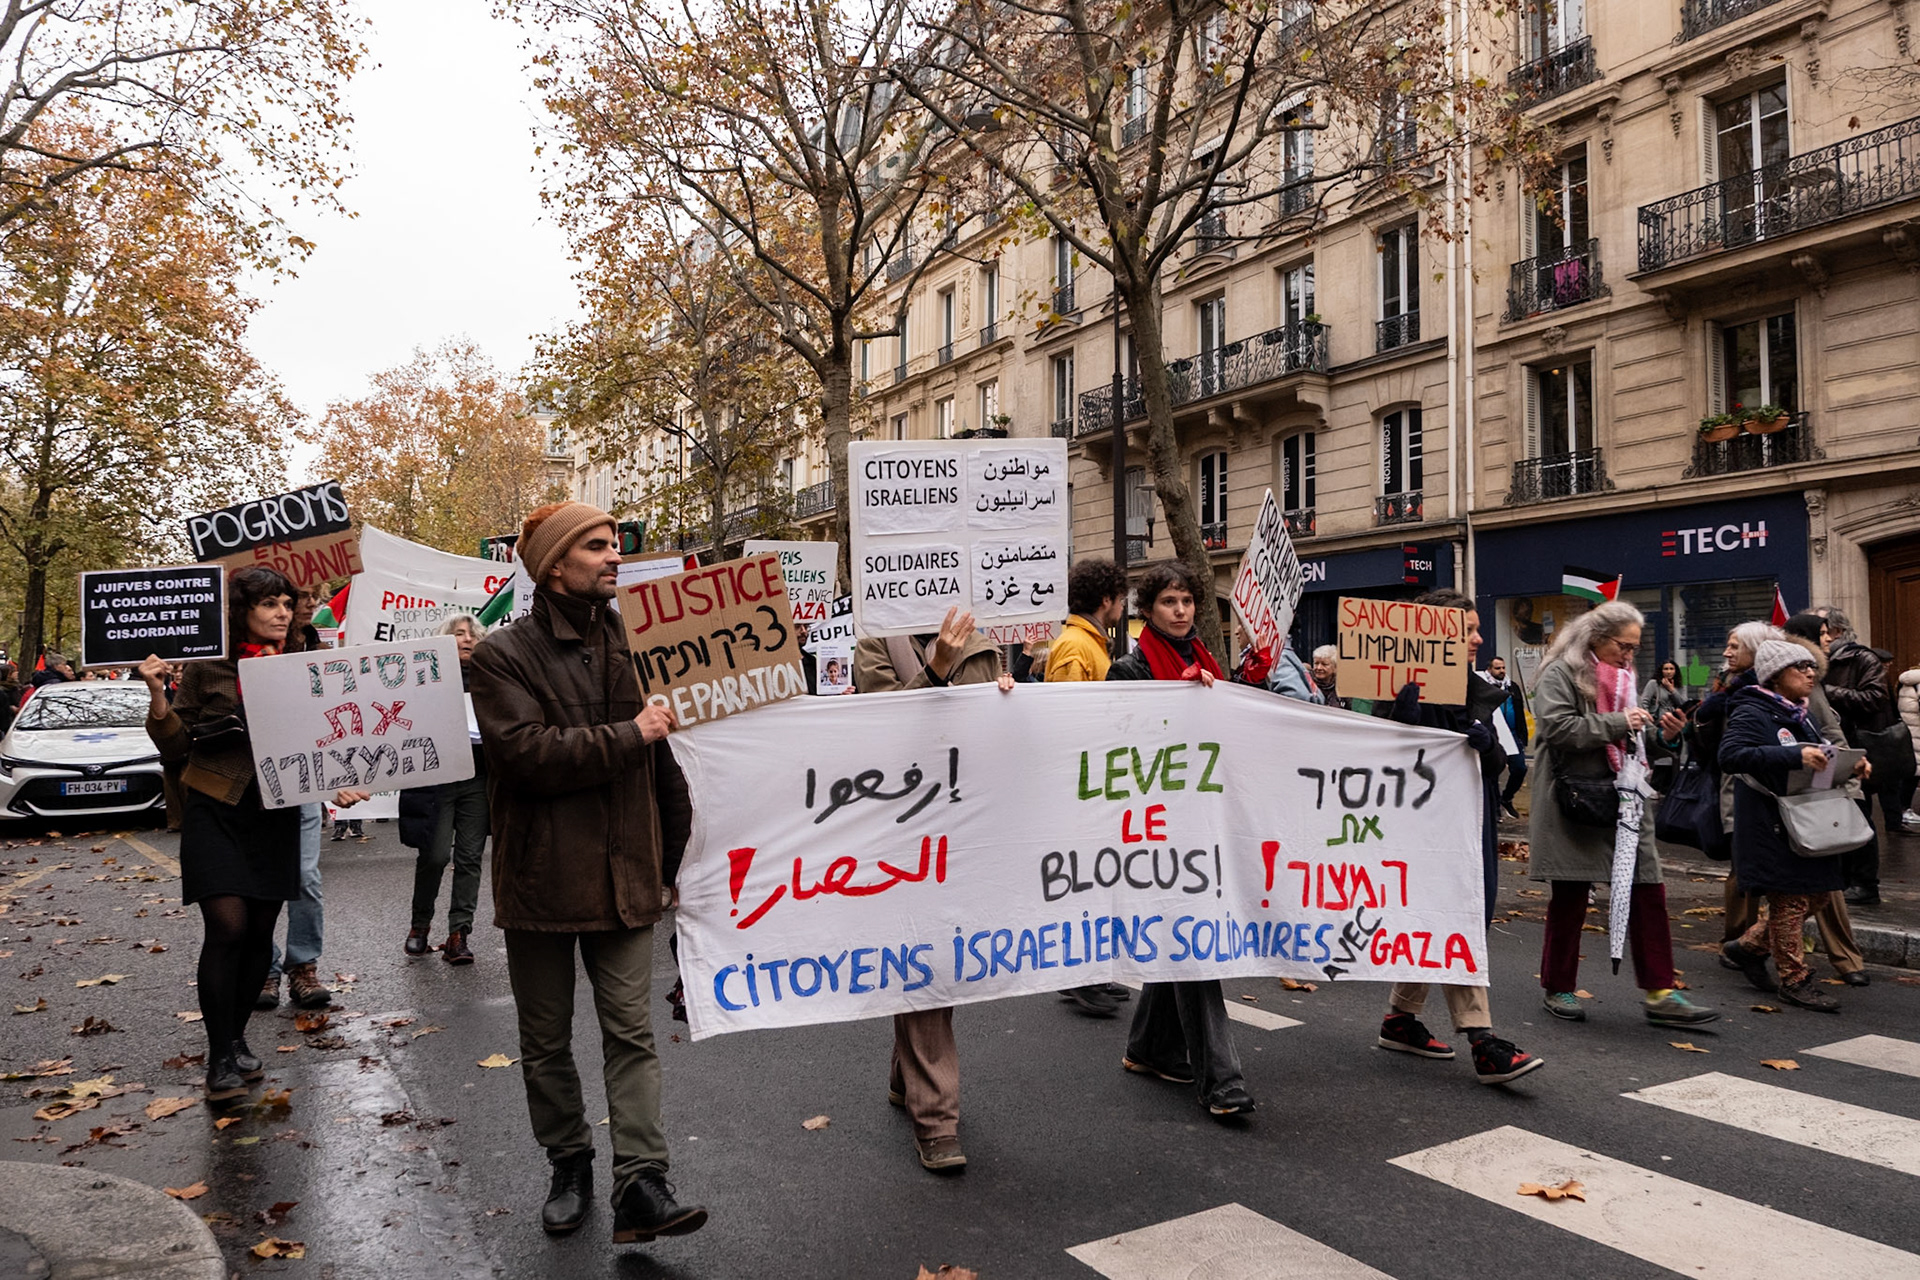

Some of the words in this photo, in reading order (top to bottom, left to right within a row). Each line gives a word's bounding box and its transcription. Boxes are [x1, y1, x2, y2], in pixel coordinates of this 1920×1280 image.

[865, 459, 958, 480] CITOYENS
[984, 457, 1049, 481] مواطنون
[866, 487, 958, 507] ISRAELIENS
[189, 482, 348, 556] POGROMS
[253, 540, 292, 560] EN
[981, 544, 1056, 570] متضامنون
[865, 552, 959, 574] SOLIDAIRES
[94, 580, 151, 594] JUIFVES
[155, 577, 211, 591] CONTRE
[628, 558, 783, 635] JUSTICE
[807, 589, 832, 604] AVEC
[865, 581, 909, 601] AVEC
[915, 577, 960, 597] GAZA
[985, 576, 1021, 606] غزة
[1030, 581, 1054, 606] مع
[1255, 549, 1284, 621] CONTRE
[90, 596, 108, 610] LA
[112, 592, 215, 608] COLONISATION
[792, 602, 826, 620] AZA
[105, 608, 116, 624] À
[119, 610, 156, 624] GAZA
[160, 610, 178, 622] ET
[181, 608, 200, 620] EN
[394, 610, 421, 624] STOP
[106, 624, 200, 640] CISJORDANIE
[810, 624, 855, 643] EUPL
[1003, 627, 1023, 644] LA
[1025, 623, 1055, 640] MER
[1340, 630, 1457, 666] L'IMPUNITÉ
[307, 650, 442, 697] הסירו
[1370, 664, 1428, 700] TUE
[316, 700, 412, 748] את
[68, 782, 119, 793] FH-034-PV
[1297, 748, 1436, 809] להסיר
[1122, 803, 1168, 844] LE
[1326, 813, 1384, 847] את
[1040, 844, 1222, 902] BLOCUS!
[1370, 927, 1477, 972] GAZA
